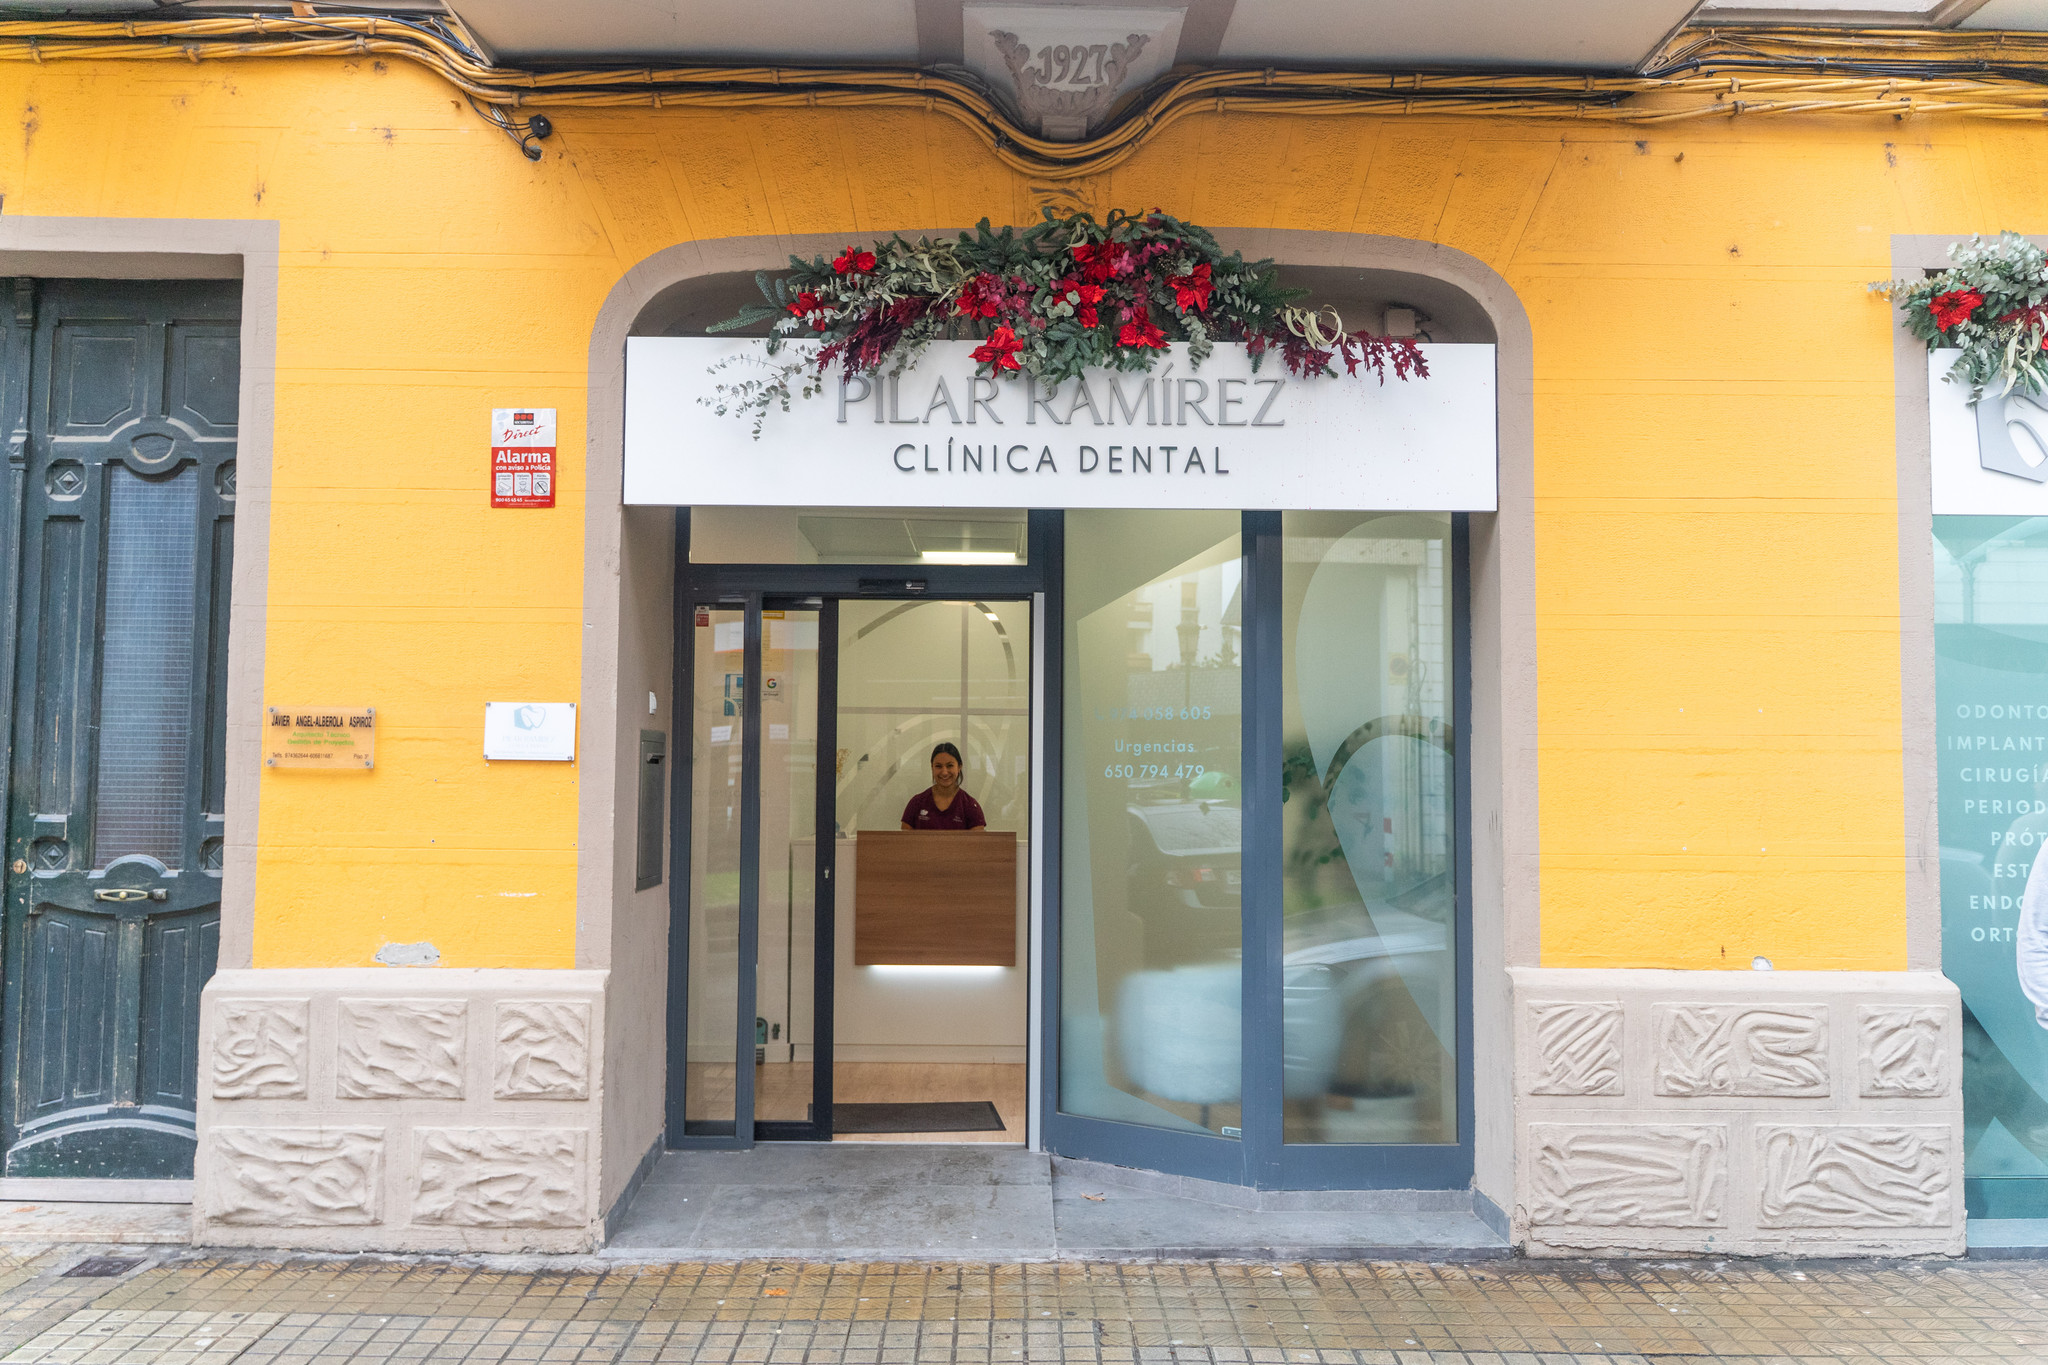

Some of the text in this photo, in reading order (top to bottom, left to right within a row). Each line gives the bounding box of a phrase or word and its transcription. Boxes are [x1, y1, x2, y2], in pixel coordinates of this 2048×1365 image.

[1036, 44, 1109, 84] 1927
[836, 362, 1286, 427] PILAR RAMÍREZ
[503, 425, 545, 443] Direct
[496, 449, 551, 463] Alarma
[893, 436, 1229, 474] CLÍNICA DENTAL
[766, 678, 777, 689] G
[1143, 707, 1174, 720] 058
[1180, 705, 1212, 720] 605
[1956, 704, 2048, 720] ODONTO
[272, 715, 372, 728] JAVIER ANGEL-ALBEROLA ASPIROZ
[1114, 739, 1195, 756] Urgencias
[1947, 735, 2046, 751] IMPLANT
[1104, 764, 1205, 779] 650 794 479
[1964, 799, 2046, 815] PERIOD
[1991, 827, 2048, 847] PRÓT
[1993, 863, 2030, 879] EST
[1971, 927, 2018, 942] ORT
